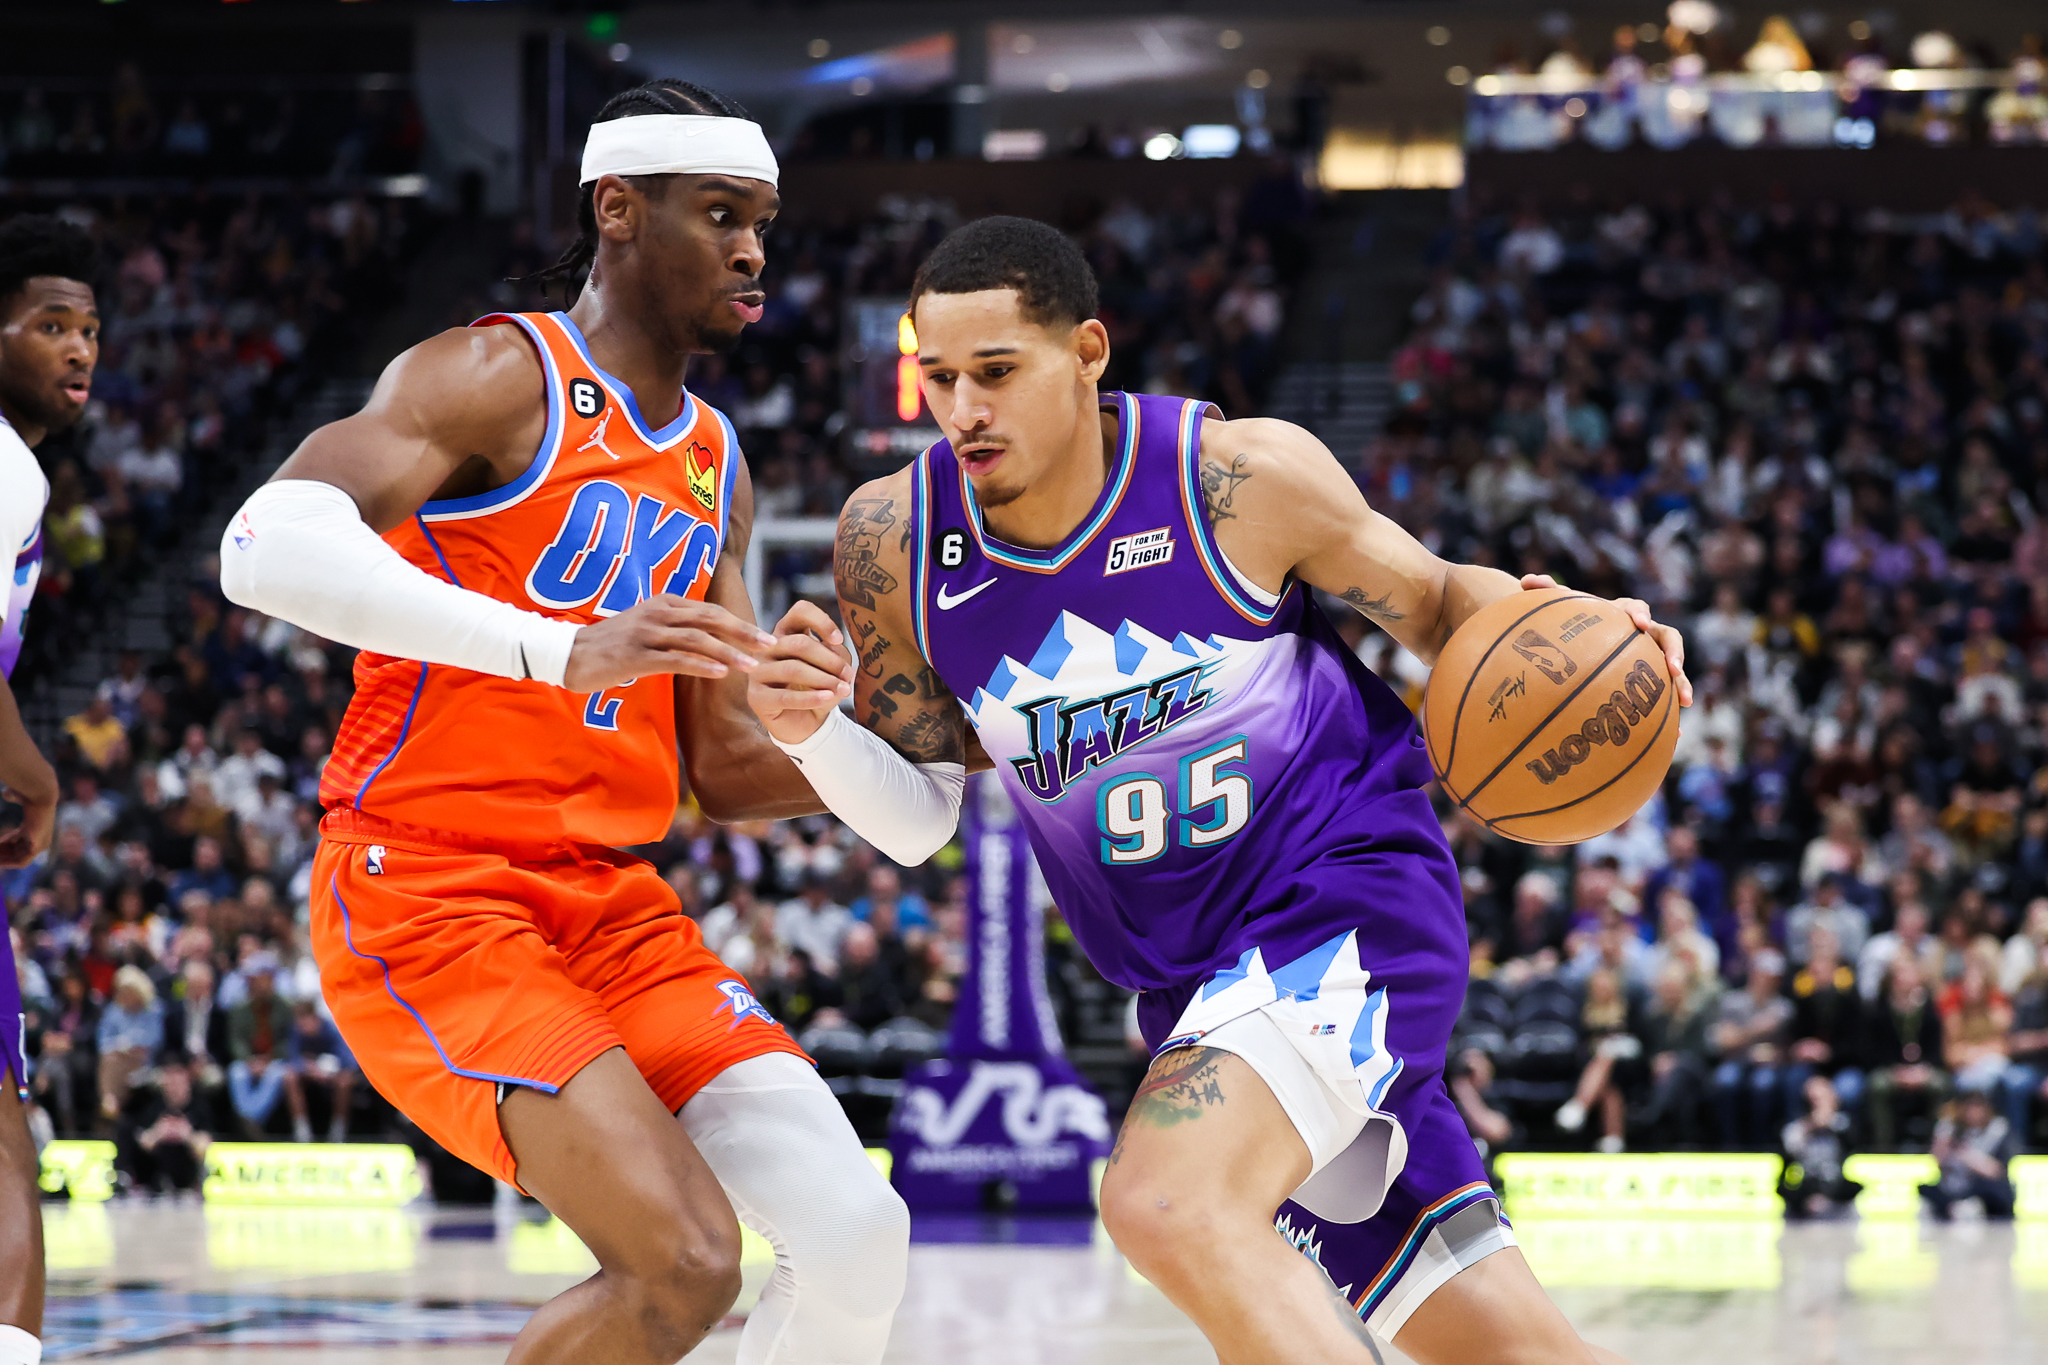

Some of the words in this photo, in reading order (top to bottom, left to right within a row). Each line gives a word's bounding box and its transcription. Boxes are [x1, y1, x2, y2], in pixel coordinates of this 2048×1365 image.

[574, 383, 597, 415] 6
[941, 533, 964, 567] 6
[1110, 541, 1127, 570] 5
[1130, 545, 1170, 566] FIGHT
[1134, 535, 1149, 546] FOR
[1151, 532, 1165, 542] THE
[1007, 660, 1218, 805] JAZZ
[1525, 659, 1666, 785] Wilson
[1096, 733, 1254, 866] 95
